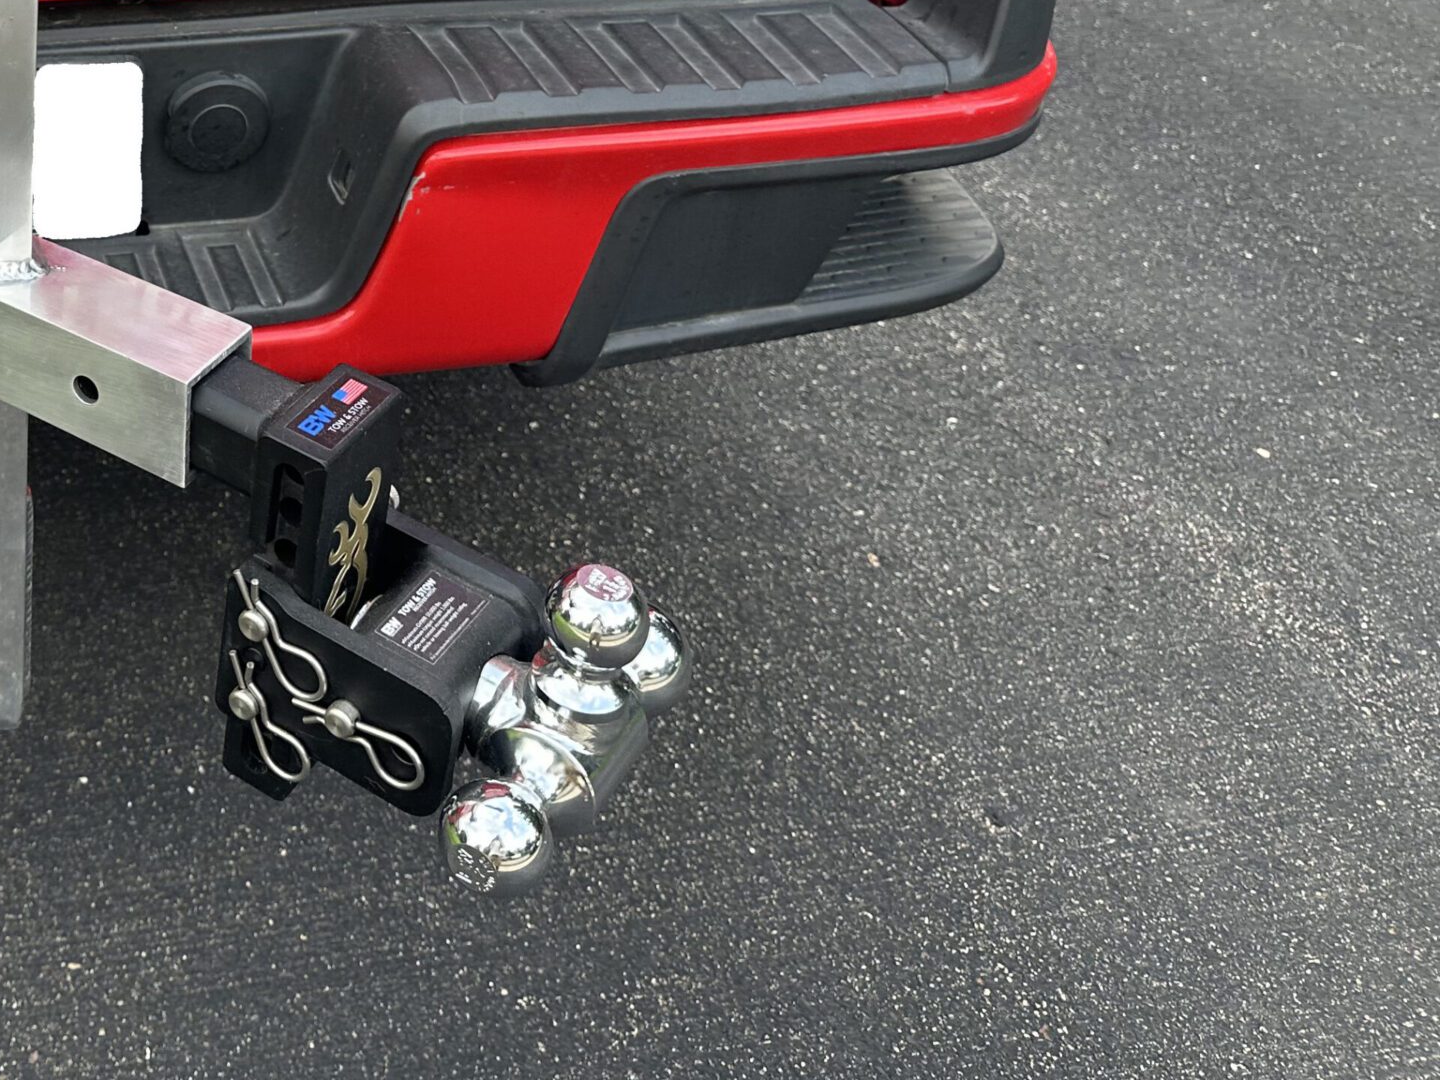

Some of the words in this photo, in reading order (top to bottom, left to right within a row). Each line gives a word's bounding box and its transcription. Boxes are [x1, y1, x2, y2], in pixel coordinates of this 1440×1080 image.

[328, 417, 347, 433] TOW
[347, 397, 369, 417] STOW
[398, 599, 416, 616] TOW
[411, 595, 421, 603] &
[416, 577, 437, 597] STOW
